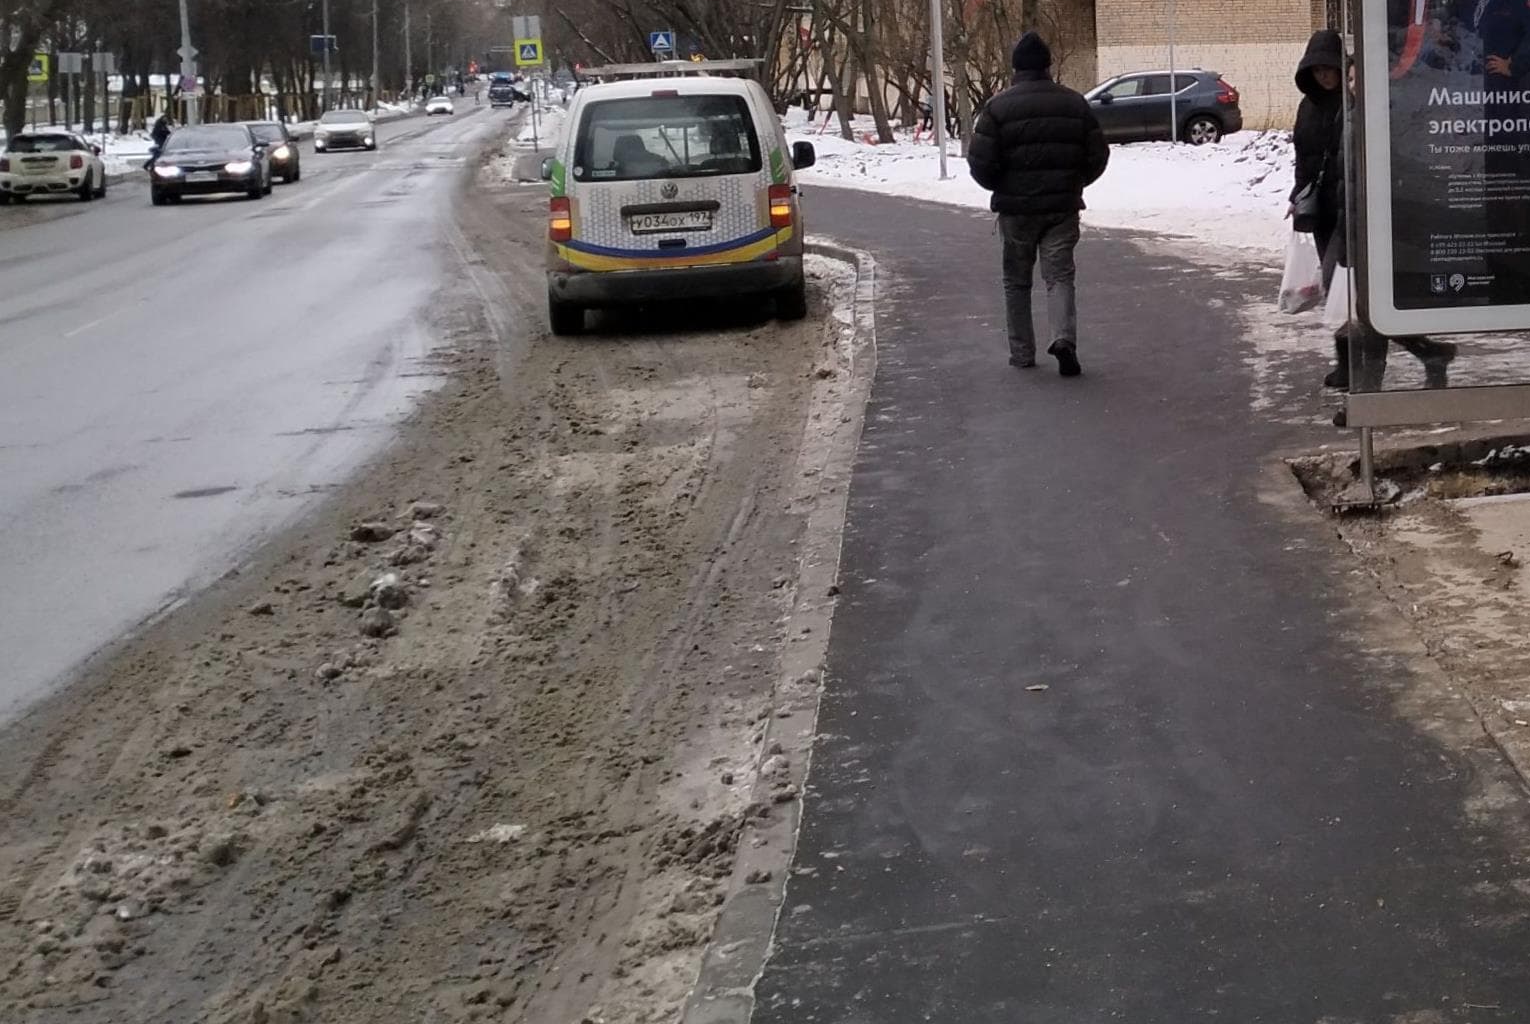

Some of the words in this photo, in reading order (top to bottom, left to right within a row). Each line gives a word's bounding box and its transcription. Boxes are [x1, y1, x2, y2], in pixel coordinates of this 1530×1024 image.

[1428, 144, 1442, 154] Ты
[1444, 145, 1470, 154] тоже
[1472, 143, 1516, 153] можешь
[689, 211, 706, 222] 197
